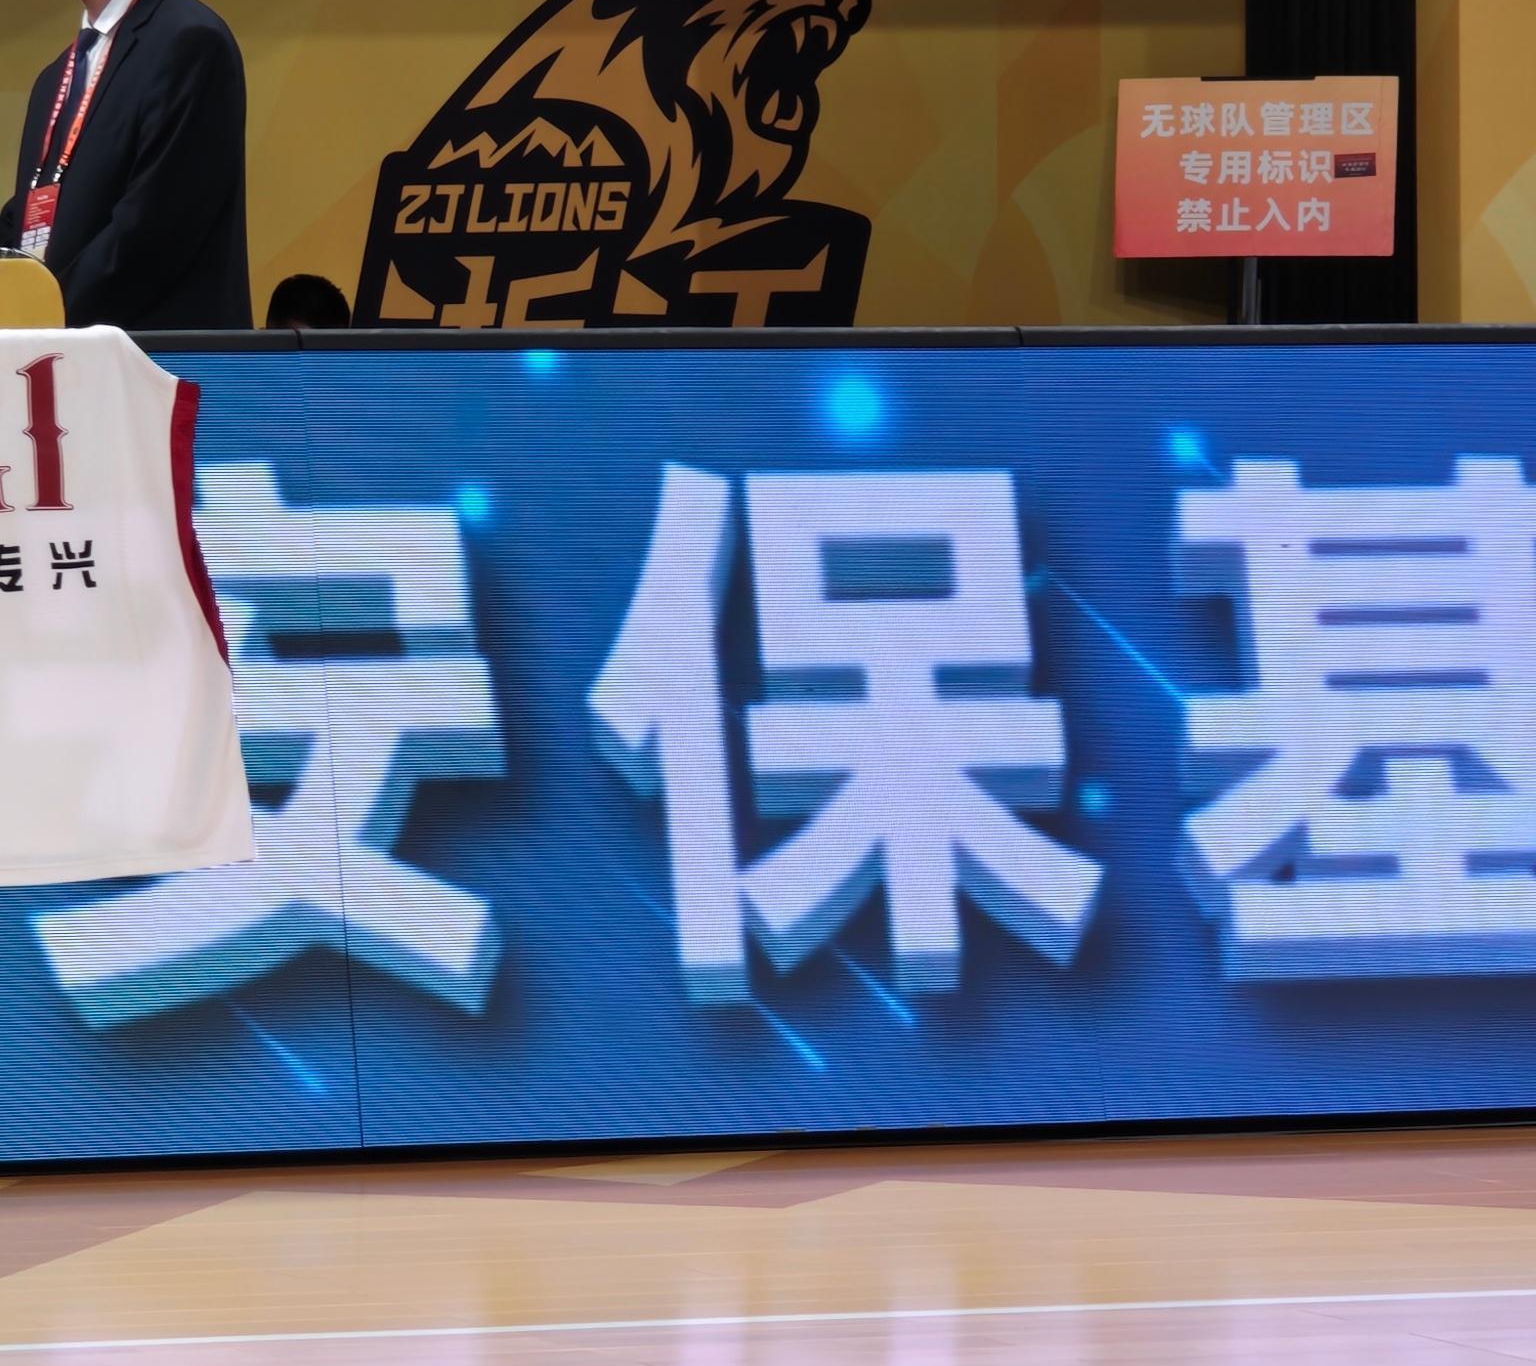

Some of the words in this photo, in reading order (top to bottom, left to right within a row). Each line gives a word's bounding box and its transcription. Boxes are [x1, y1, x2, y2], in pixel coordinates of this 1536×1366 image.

[1140, 101, 1375, 138] 无球队管理区
[1179, 150, 1334, 185] 专用标识
[465, 181, 632, 233] LIONS
[1176, 197, 1331, 233] 禁止入内
